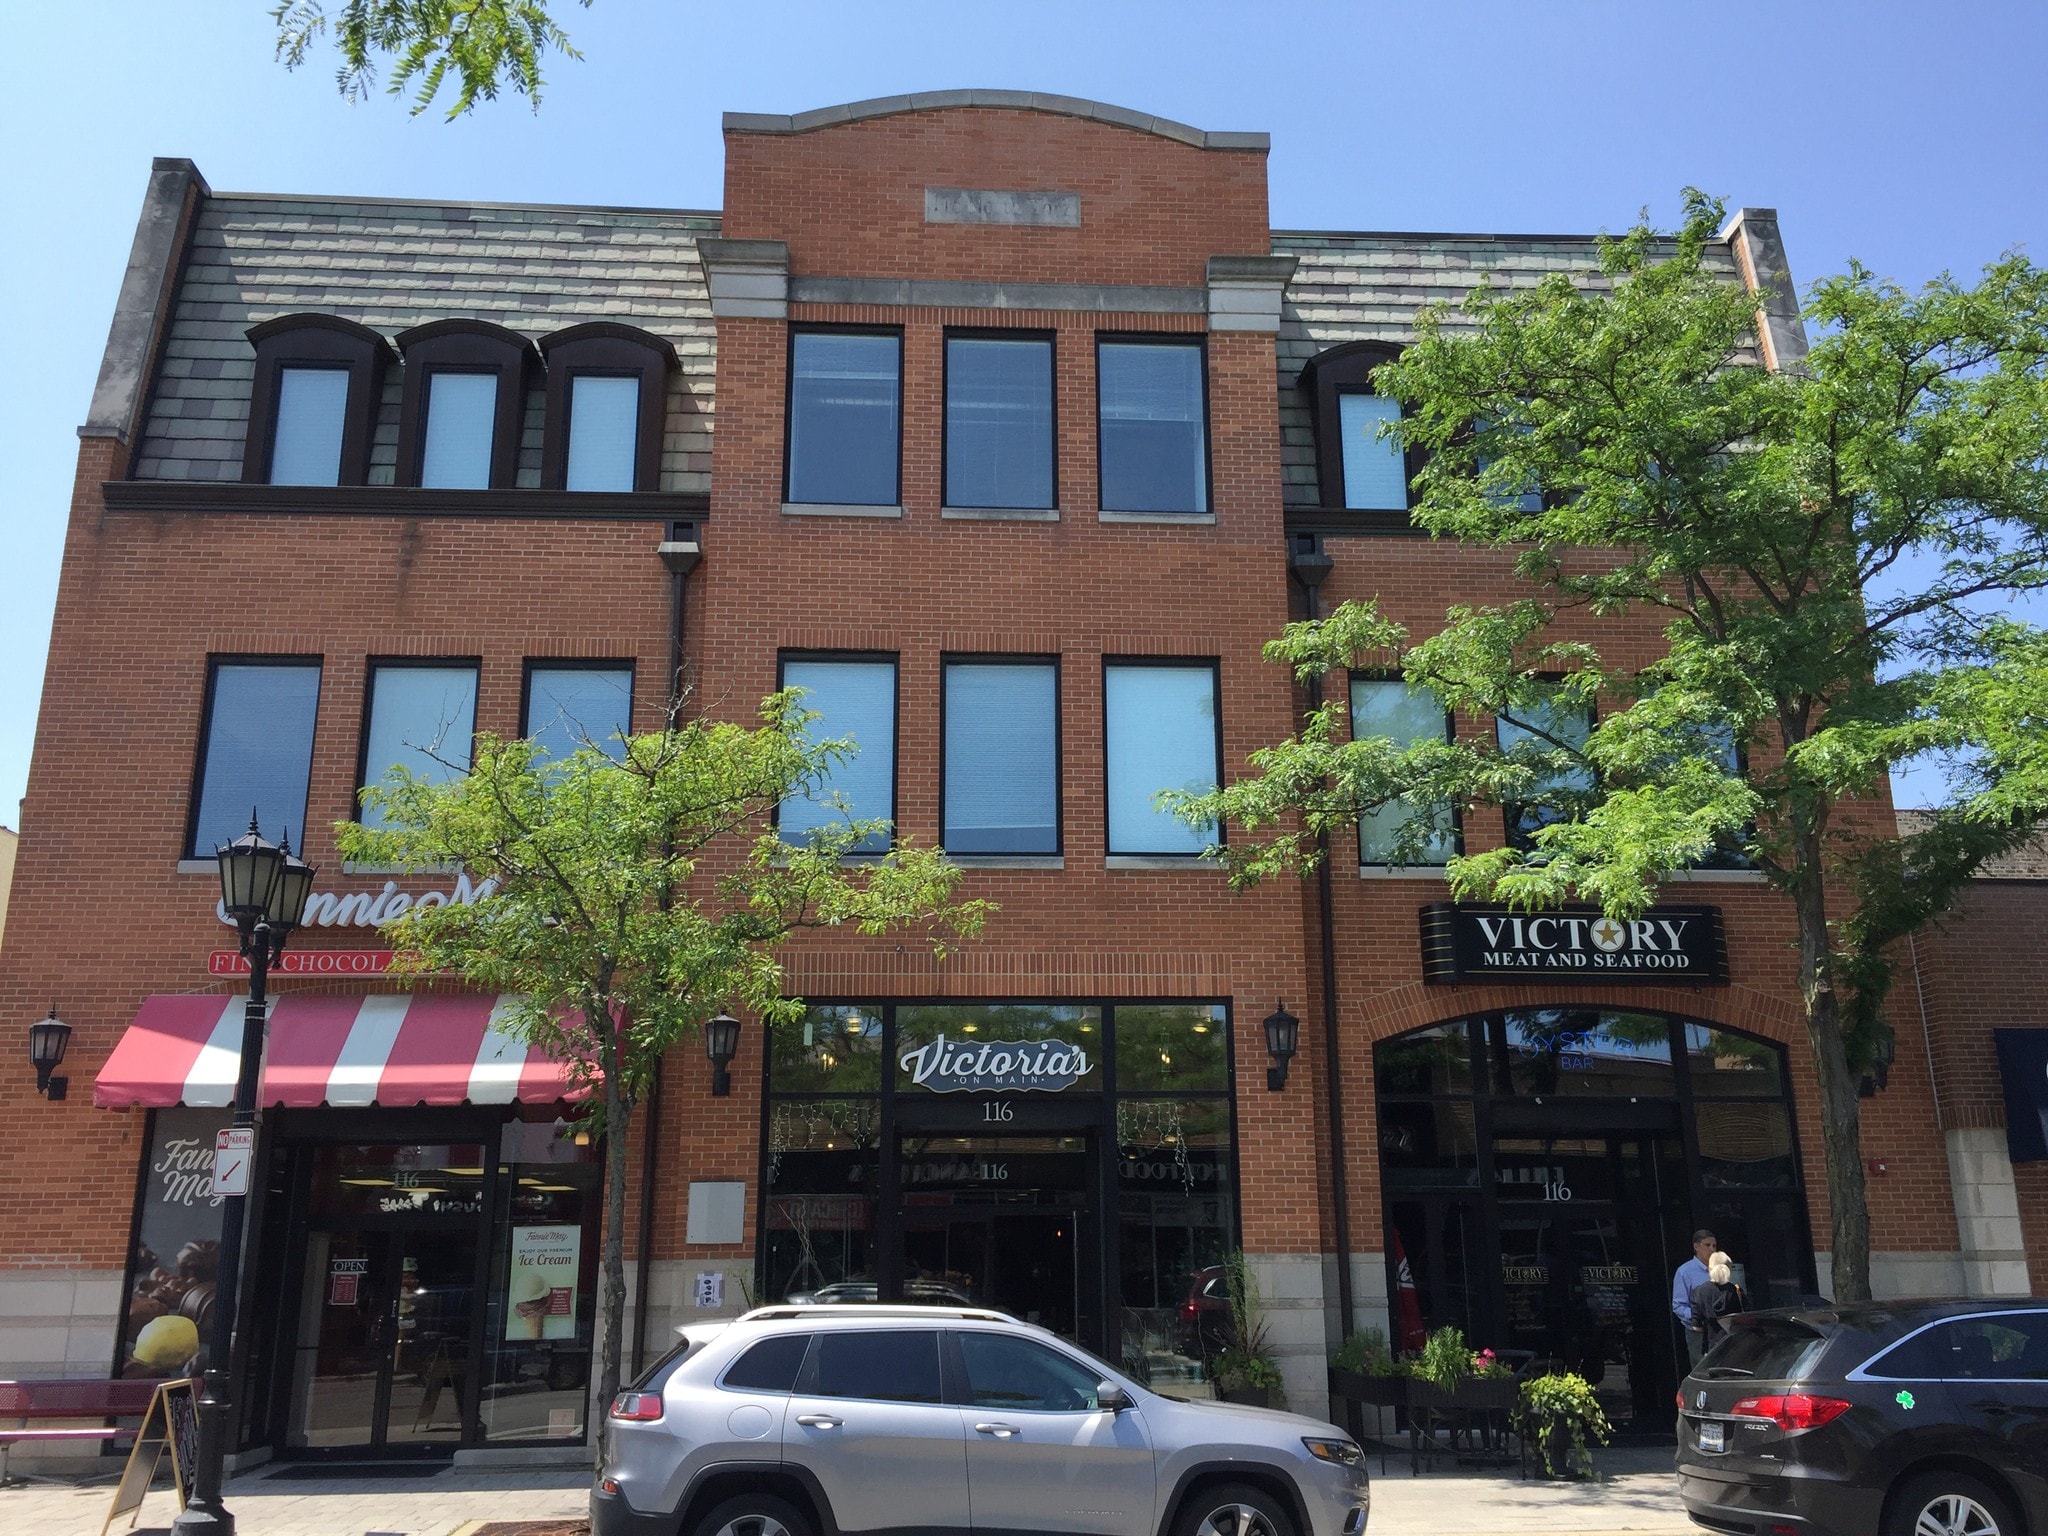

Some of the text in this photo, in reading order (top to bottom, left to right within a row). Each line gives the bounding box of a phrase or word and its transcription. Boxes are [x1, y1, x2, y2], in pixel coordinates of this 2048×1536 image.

[217, 880, 411, 927] nnie
[1475, 917, 1689, 952] VICTORY
[214, 954, 258, 972] FIN
[1483, 952, 1690, 969] MEAT AND SEAFOOD
[1519, 1031, 1635, 1058] OYSTER
[900, 1033, 1094, 1084] Victoria's
[1561, 1056, 1595, 1070] BAR
[959, 1075, 1038, 1085] ON MAIN
[982, 1101, 1013, 1121] 116
[219, 1134, 250, 1147] NO PARKING
[154, 1138, 216, 1172] Fan
[392, 1171, 420, 1188] 116
[982, 1163, 1008, 1180] 116
[1542, 1180, 1572, 1201] 116
[334, 1261, 366, 1272] OPEN
[518, 1253, 572, 1266] Ice Cream
